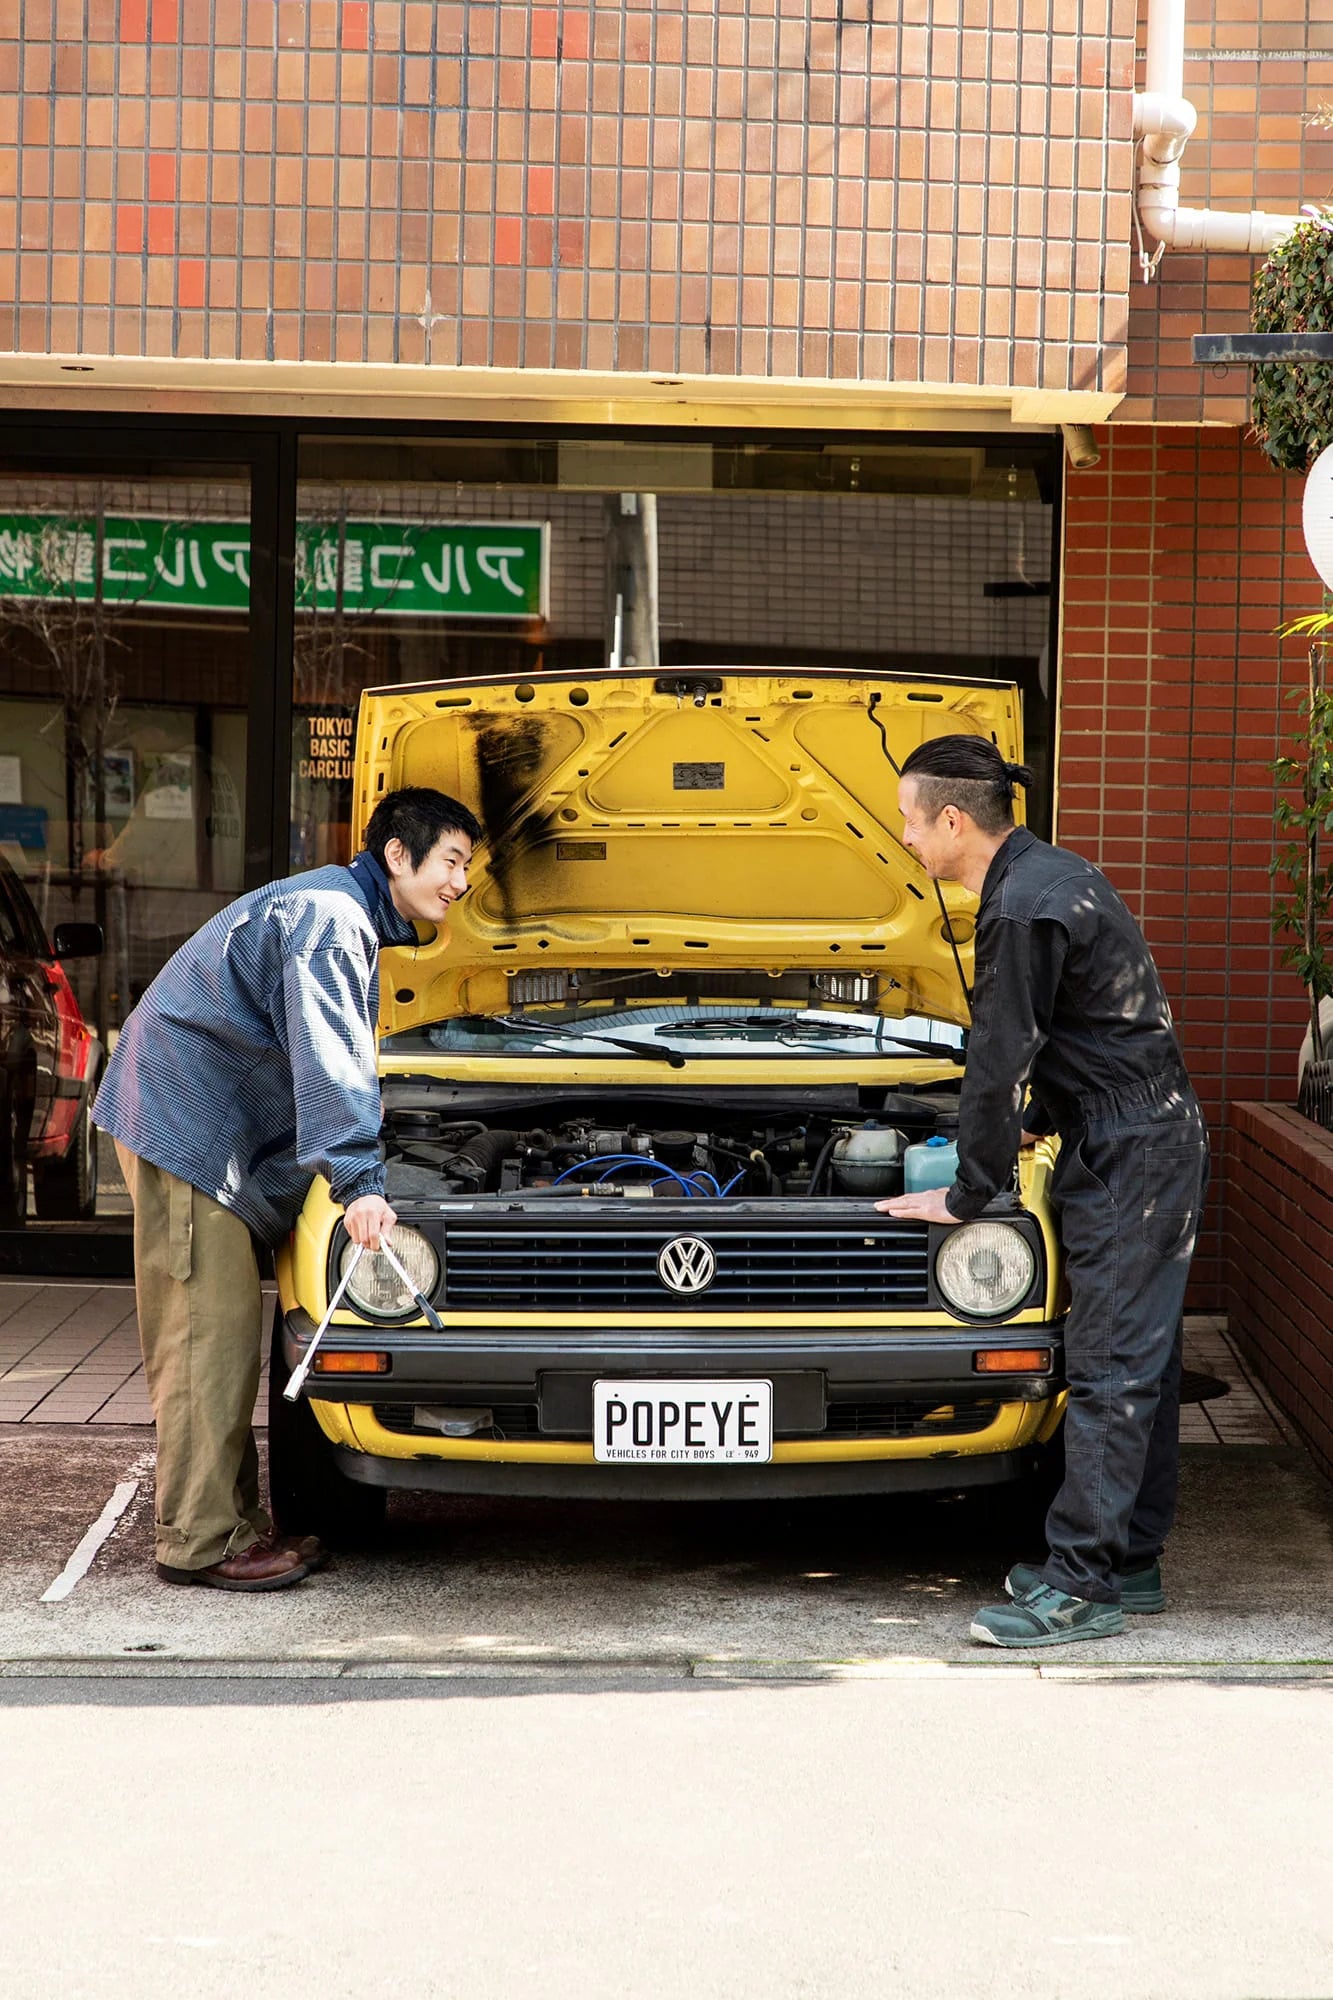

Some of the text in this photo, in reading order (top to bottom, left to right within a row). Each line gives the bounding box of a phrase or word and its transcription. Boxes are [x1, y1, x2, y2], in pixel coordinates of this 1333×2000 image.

[308, 716, 353, 737] TOKYO
[310, 738, 350, 757] BASIC
[299, 759, 356, 779] CARCLU
[660, 1237, 714, 1291] VW
[606, 1400, 760, 1447] POPEYE
[606, 1449, 647, 1459] VEHICLES
[650, 1450, 668, 1459] FOR
[670, 1450, 690, 1459] CITY
[693, 1450, 715, 1459] BOYS
[744, 1449, 759, 1459] 949
